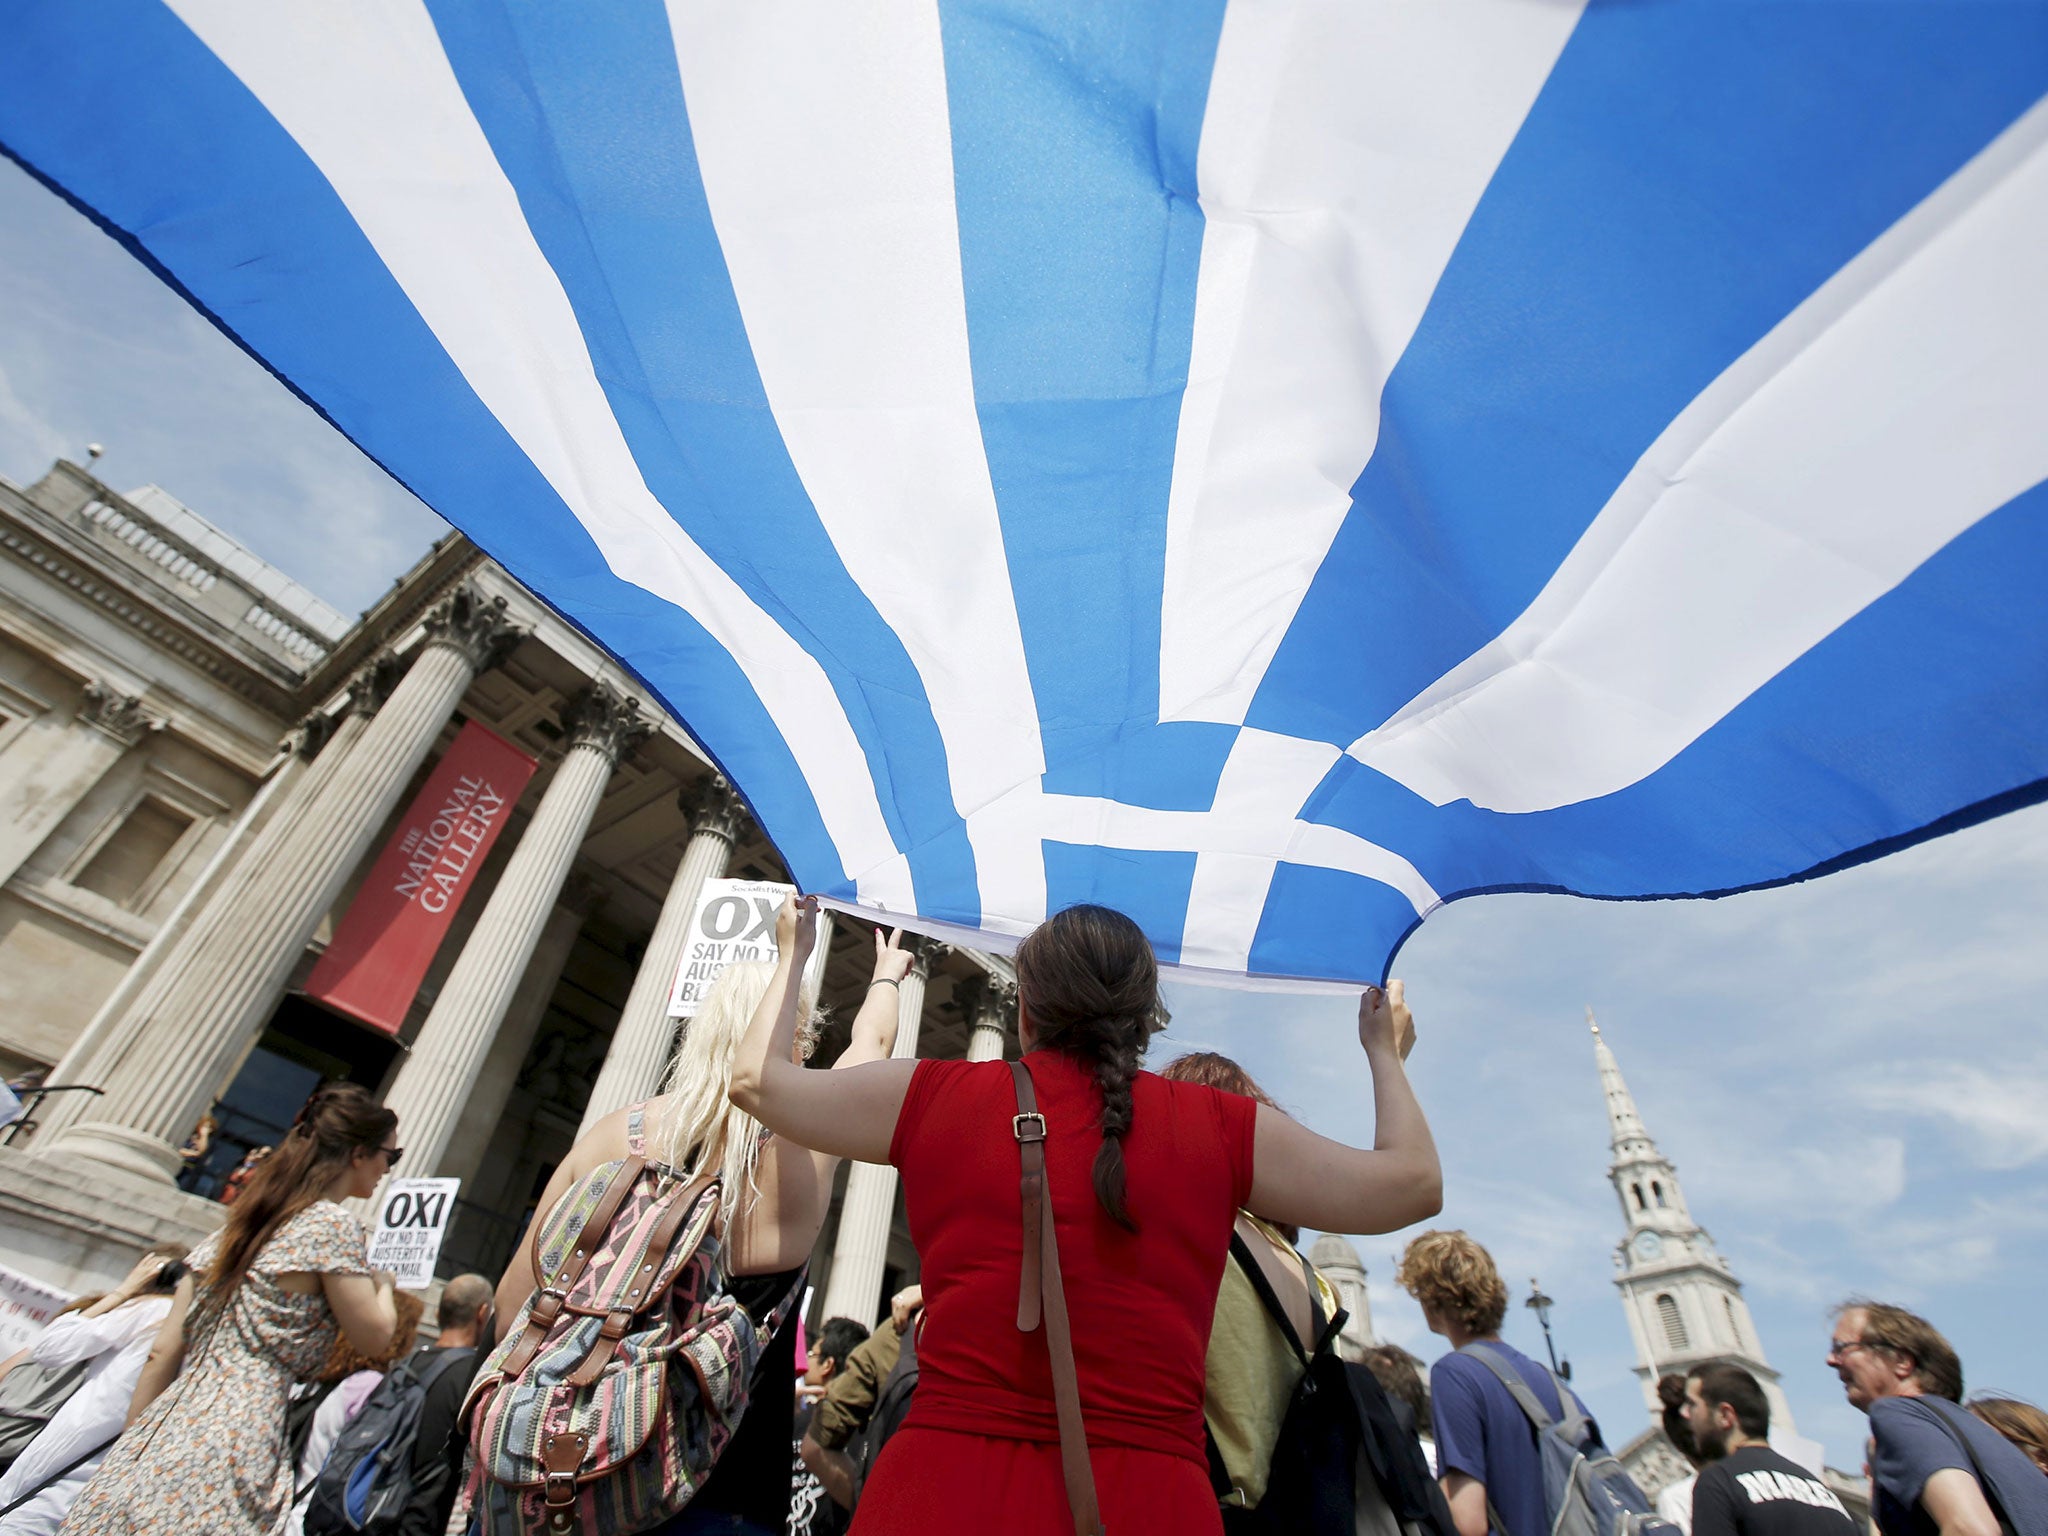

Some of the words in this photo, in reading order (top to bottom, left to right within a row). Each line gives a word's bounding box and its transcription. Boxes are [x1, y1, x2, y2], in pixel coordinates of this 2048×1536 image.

[394, 775, 484, 901] NATIONAL
[401, 827, 422, 853] THE
[420, 784, 505, 913] GALLERY
[701, 896, 783, 946] OX
[692, 943, 728, 961] SAY
[732, 944, 760, 962] NO
[767, 948, 780, 962] T
[685, 962, 731, 981] AUS
[385, 1193, 447, 1228] OXI
[376, 1231, 395, 1245] SAY
[398, 1231, 414, 1245] NO
[416, 1231, 428, 1245] TO
[371, 1247, 425, 1260] AUSTERITY
[426, 1247, 435, 1260] &
